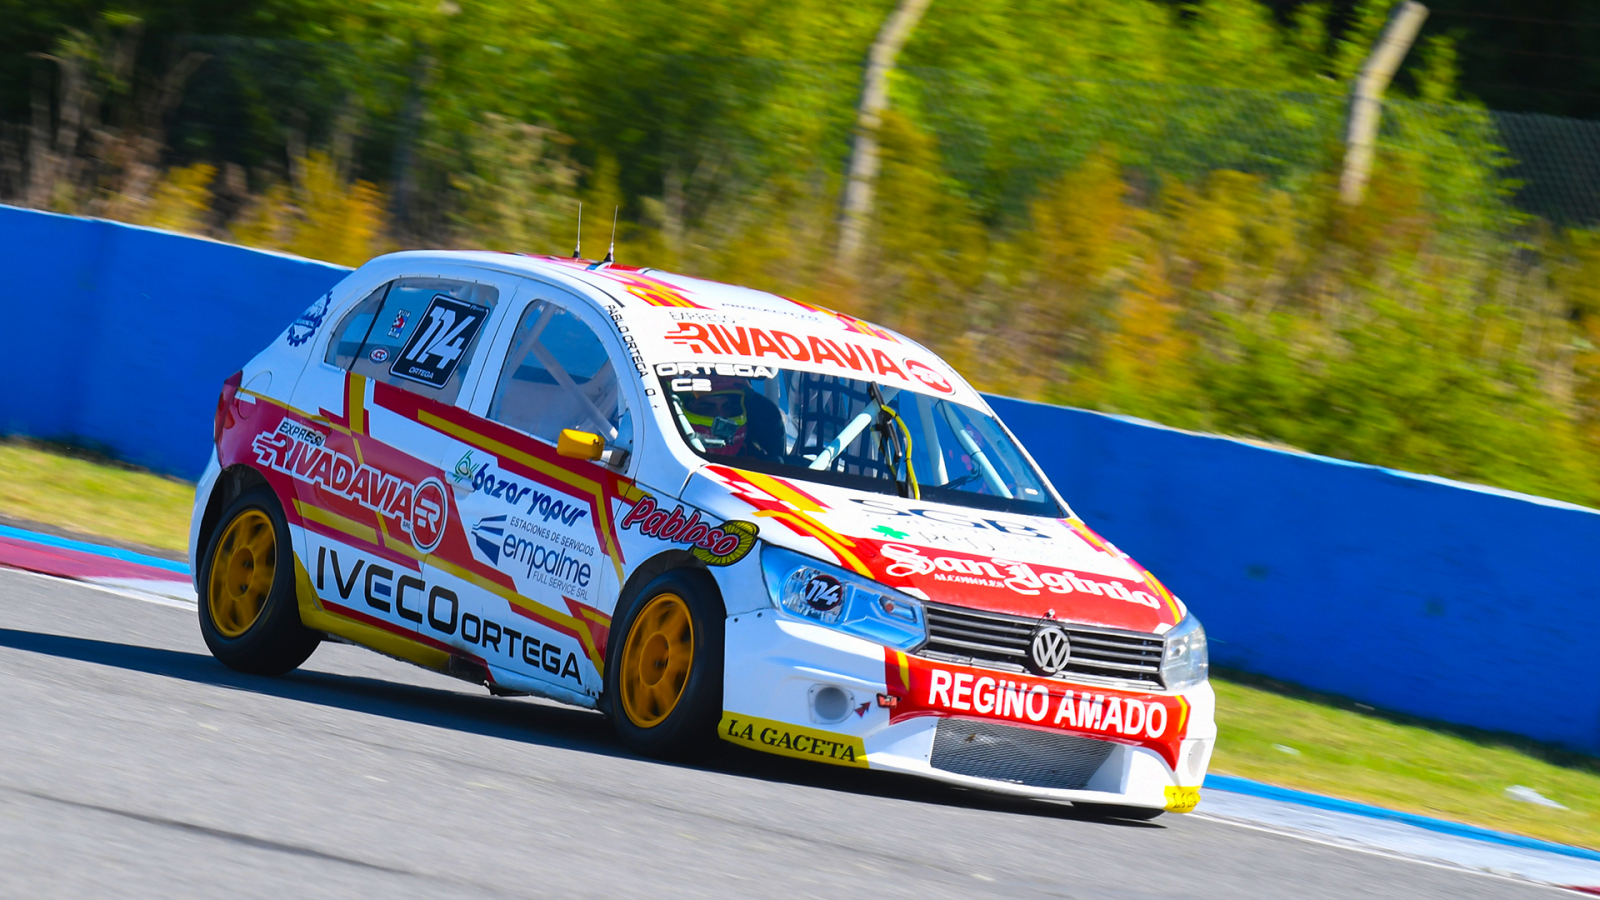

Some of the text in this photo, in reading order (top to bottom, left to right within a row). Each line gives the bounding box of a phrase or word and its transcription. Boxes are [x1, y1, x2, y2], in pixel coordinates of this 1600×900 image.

[405, 305, 476, 370] 114
[604, 304, 630, 334] PABLO
[622, 334, 649, 379] ORTEGA
[663, 322, 911, 382] RIVADAVIA
[408, 366, 435, 379] ORTEGA
[655, 363, 774, 380] ORTEGA
[671, 378, 713, 392] C2
[252, 431, 416, 520] RIVADAVIA
[471, 463, 532, 506] bazar
[526, 490, 588, 527] yapur
[510, 516, 595, 557] ESTACIONES DE SERVICIOS
[622, 495, 740, 556] Pabloso
[502, 533, 592, 588] empalme
[533, 570, 548, 585] FULL
[549, 576, 577, 595] SERVICE
[879, 543, 1006, 577] San
[316, 546, 583, 686] IVECO ORTEGA
[805, 580, 841, 606] 114
[928, 668, 1168, 739] REGINO AMADO
[727, 719, 858, 764] LA GACETA
